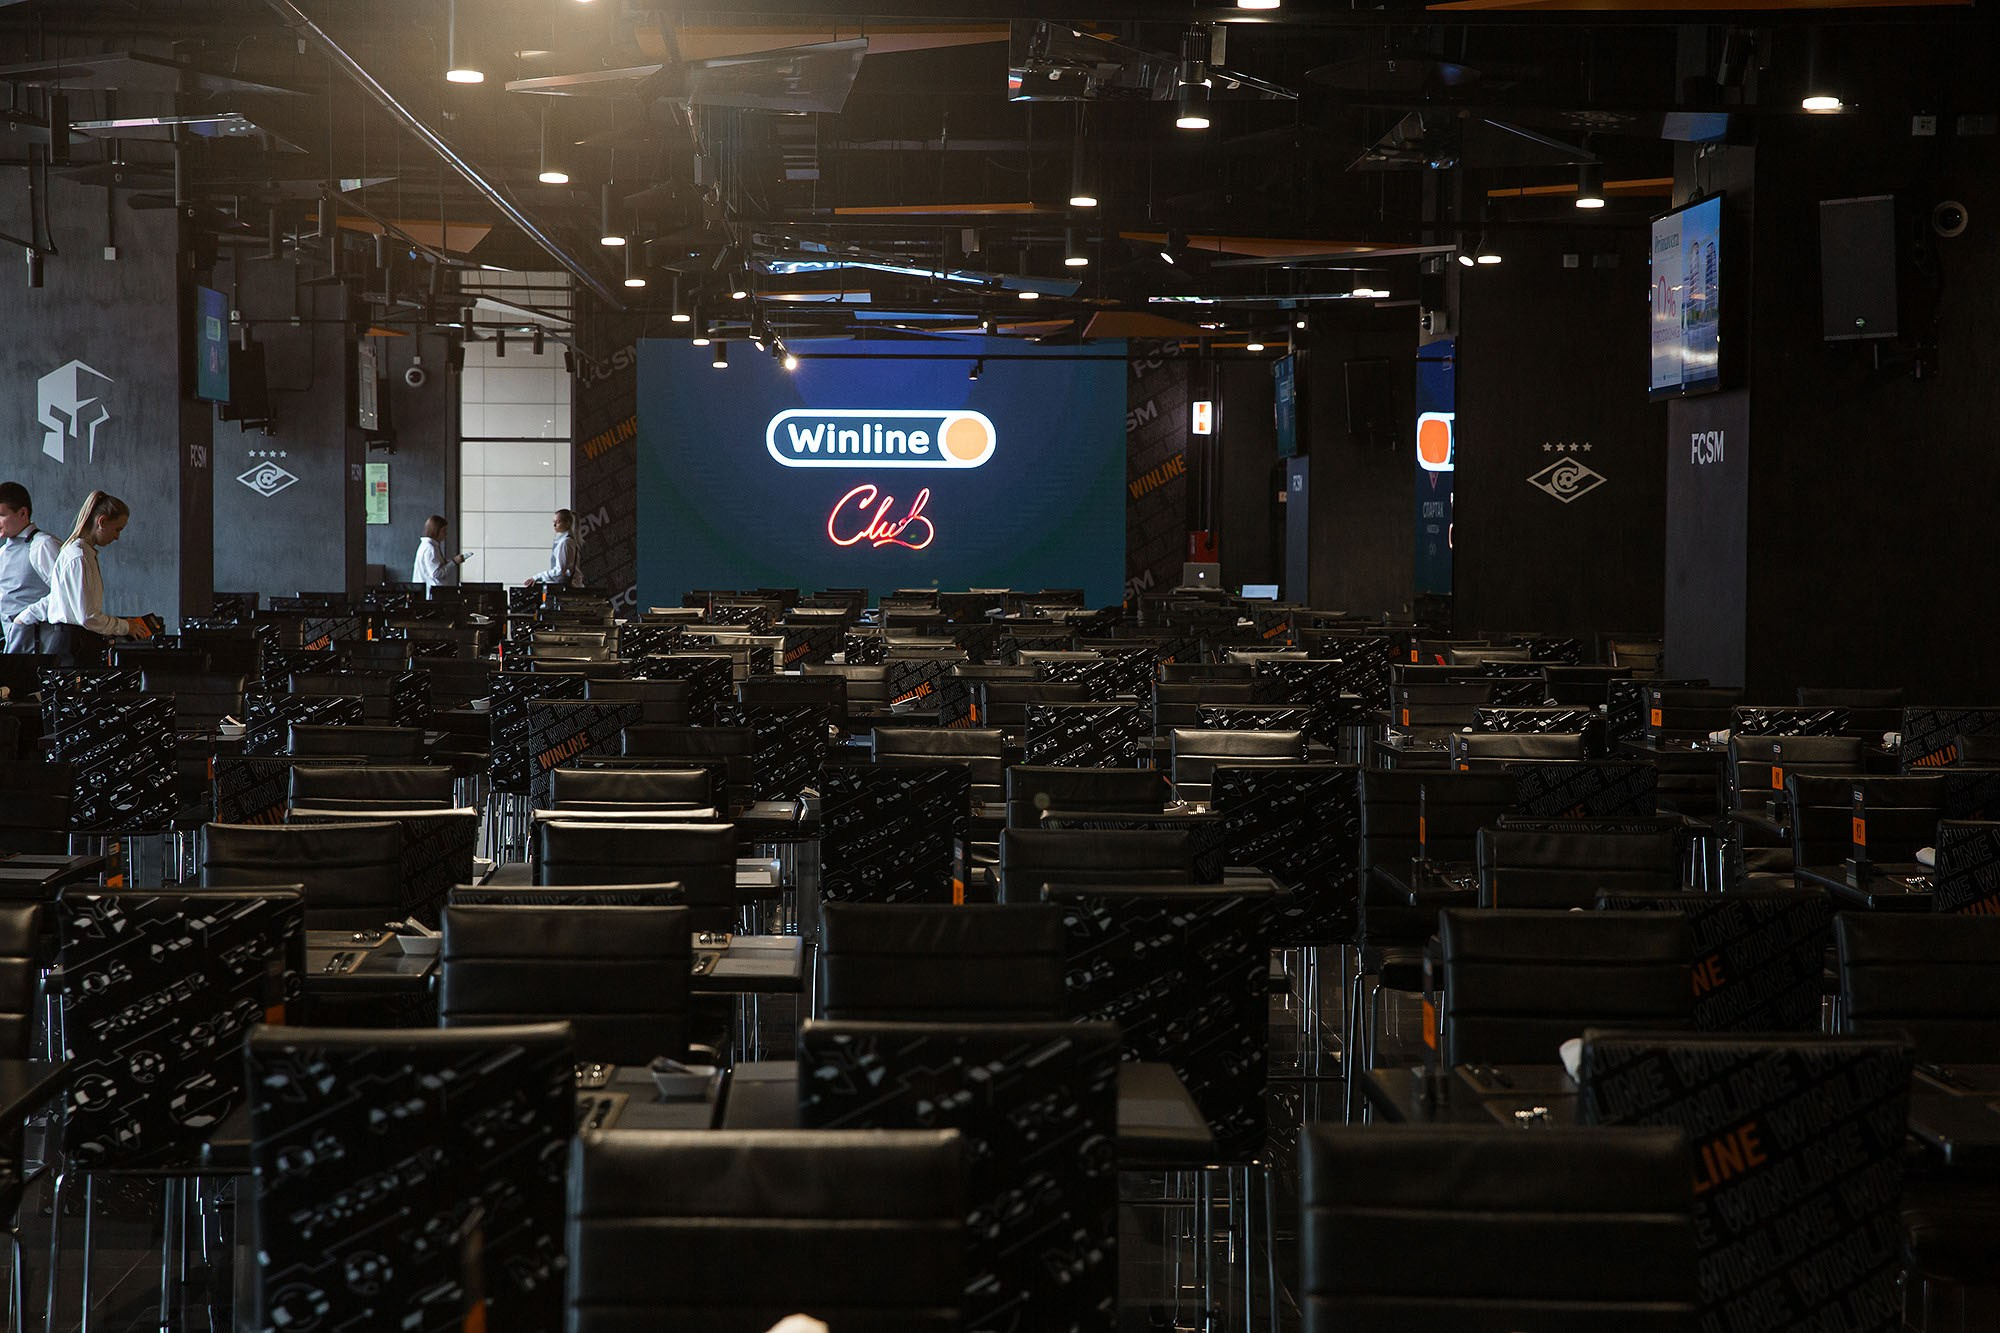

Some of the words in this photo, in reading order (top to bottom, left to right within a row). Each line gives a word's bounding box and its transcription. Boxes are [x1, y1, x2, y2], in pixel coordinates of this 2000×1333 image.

[190, 444, 207, 468] FCSM
[787, 422, 931, 455] Winline
[1691, 430, 1724, 465] FCSM
[1129, 454, 1187, 500] WINLINE
[826, 483, 935, 551] Club
[538, 730, 590, 771] WINLINE
[1692, 1120, 1768, 1196] LINE
